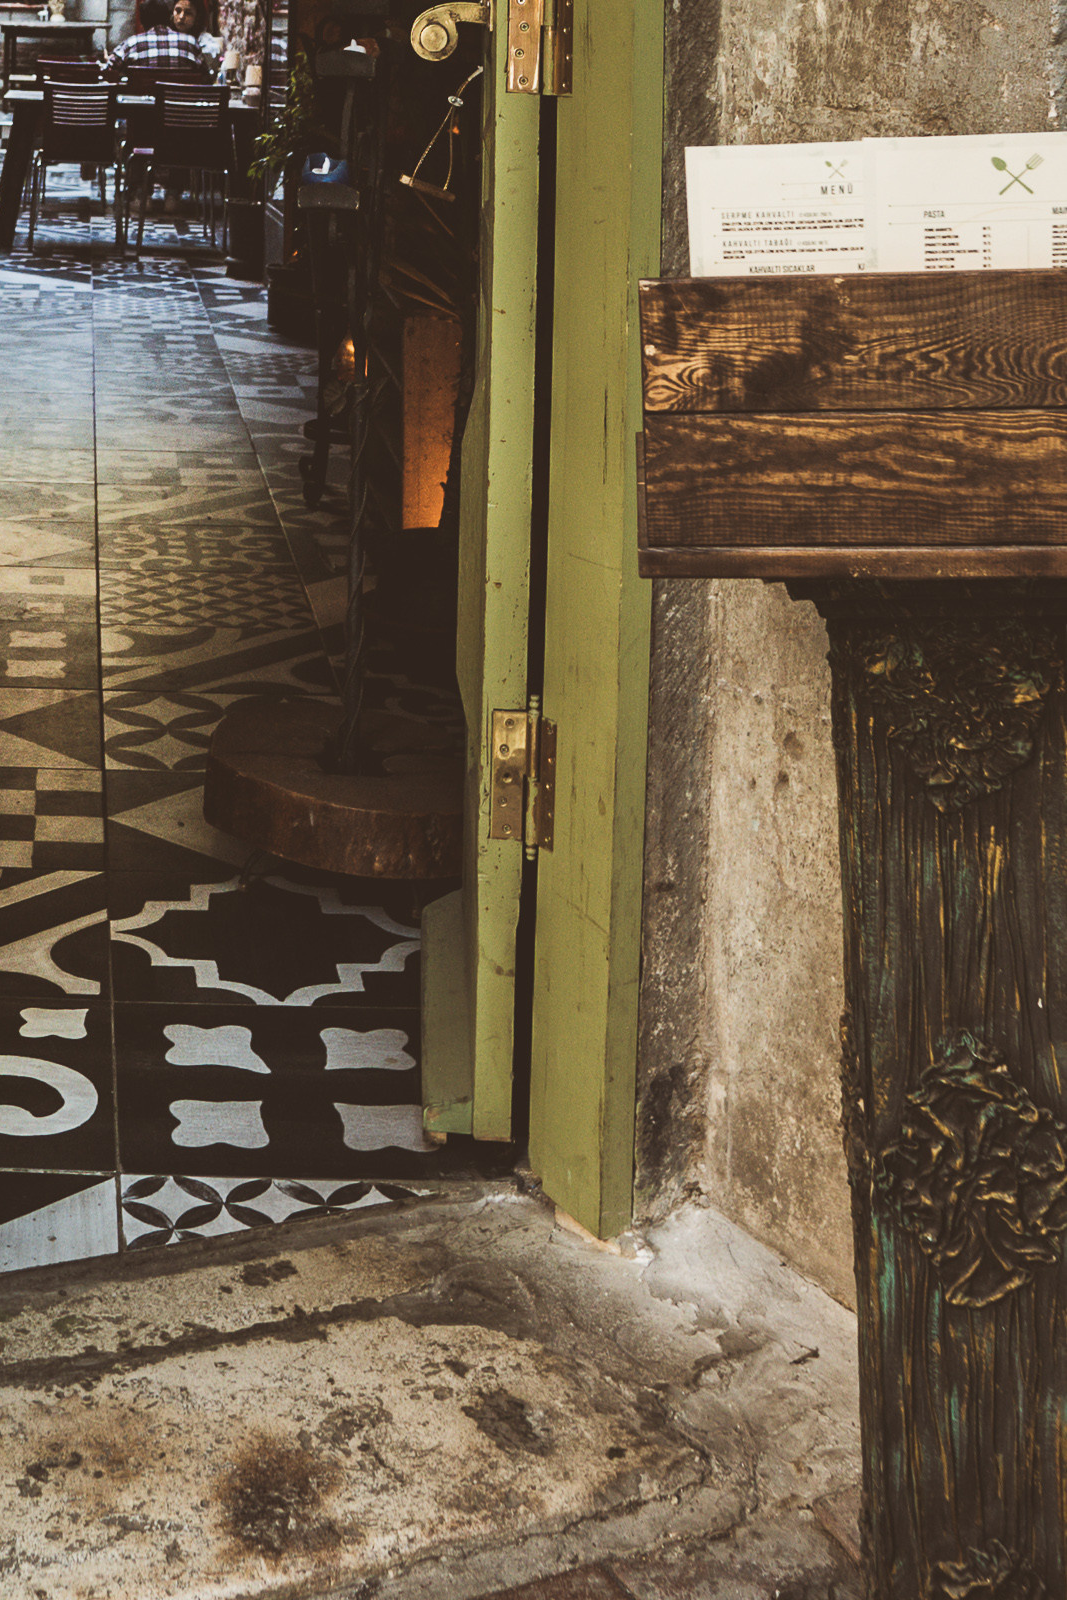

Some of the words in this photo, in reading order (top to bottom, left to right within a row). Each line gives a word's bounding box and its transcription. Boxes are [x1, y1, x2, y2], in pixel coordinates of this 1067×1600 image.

[755, 210, 794, 218] KAHVALTI
[923, 210, 945, 218] PASTA
[722, 239, 761, 247] KAHVALTI
[749, 265, 781, 274] KAHVALTI
